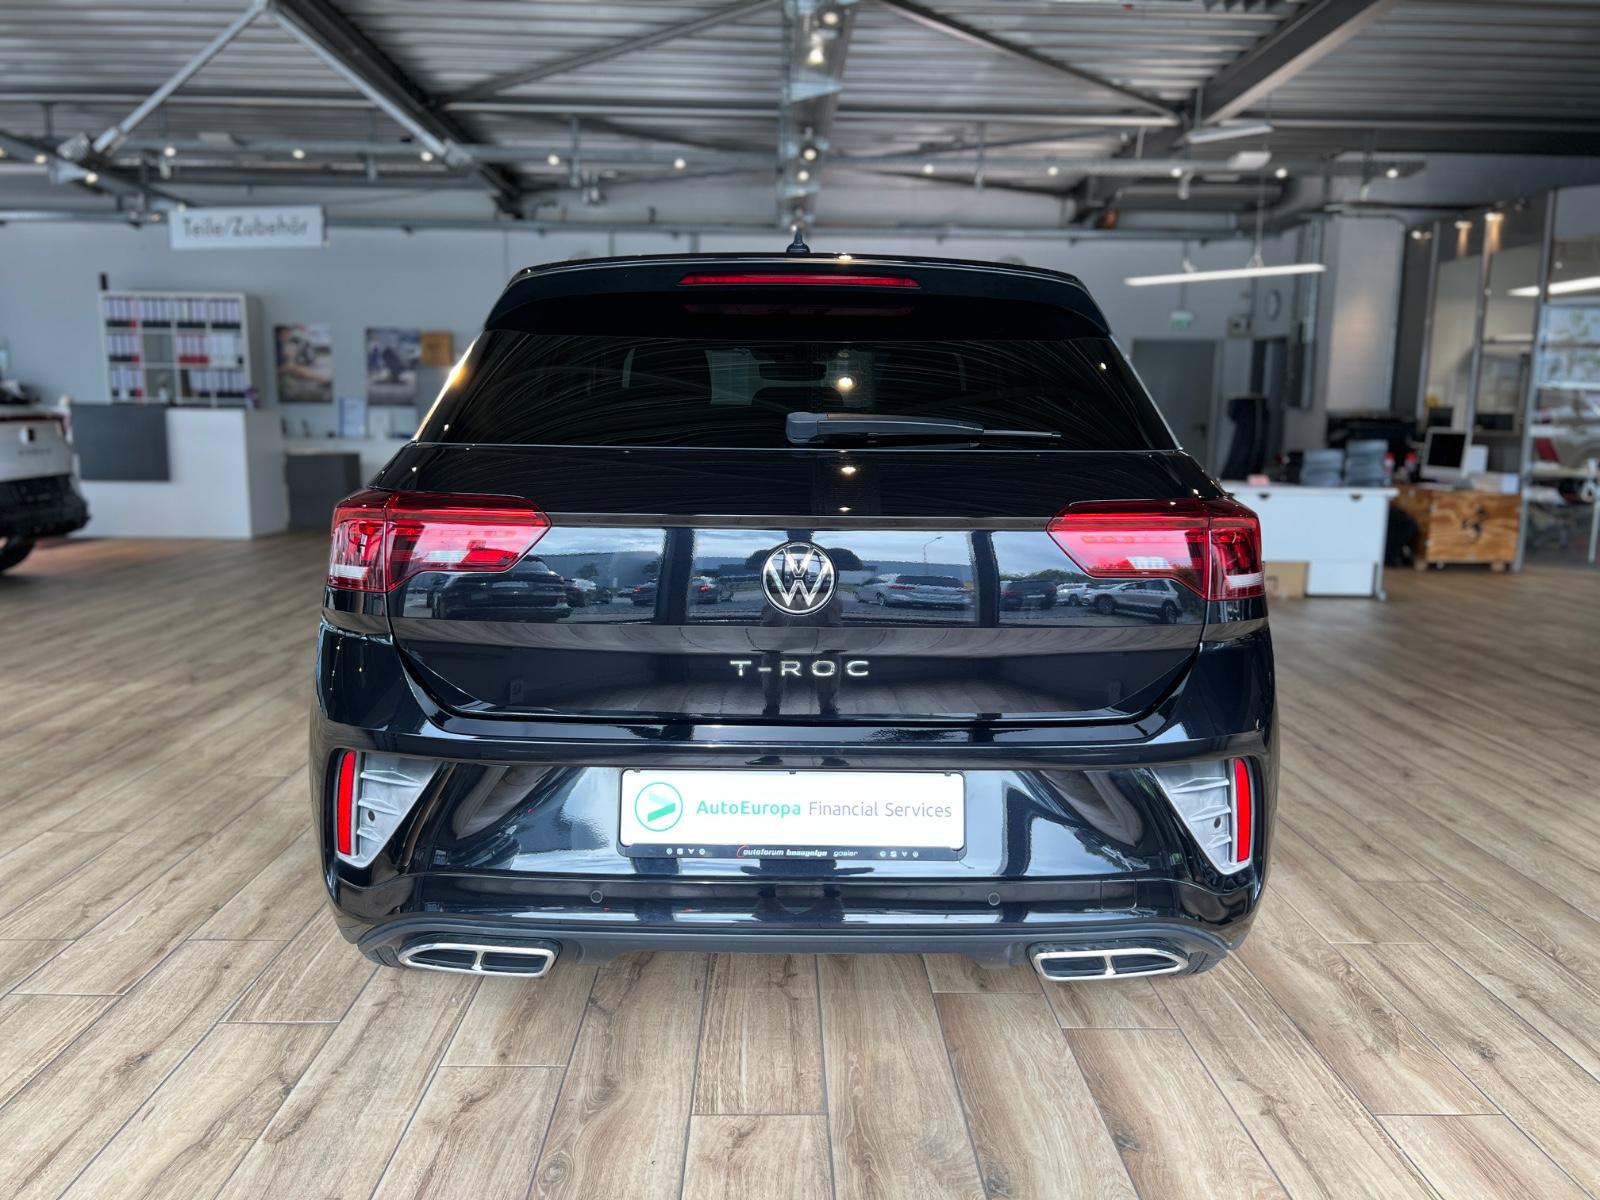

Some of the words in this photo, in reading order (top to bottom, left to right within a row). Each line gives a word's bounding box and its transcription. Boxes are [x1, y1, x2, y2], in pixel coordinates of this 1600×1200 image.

[181, 213, 308, 238] Teile/Zubehör
[764, 543, 836, 614] VW
[729, 660, 870, 677] T-ROC
[696, 800, 801, 818] AutoEuropa
[808, 801, 879, 817] Financial
[884, 802, 953, 818] Services
